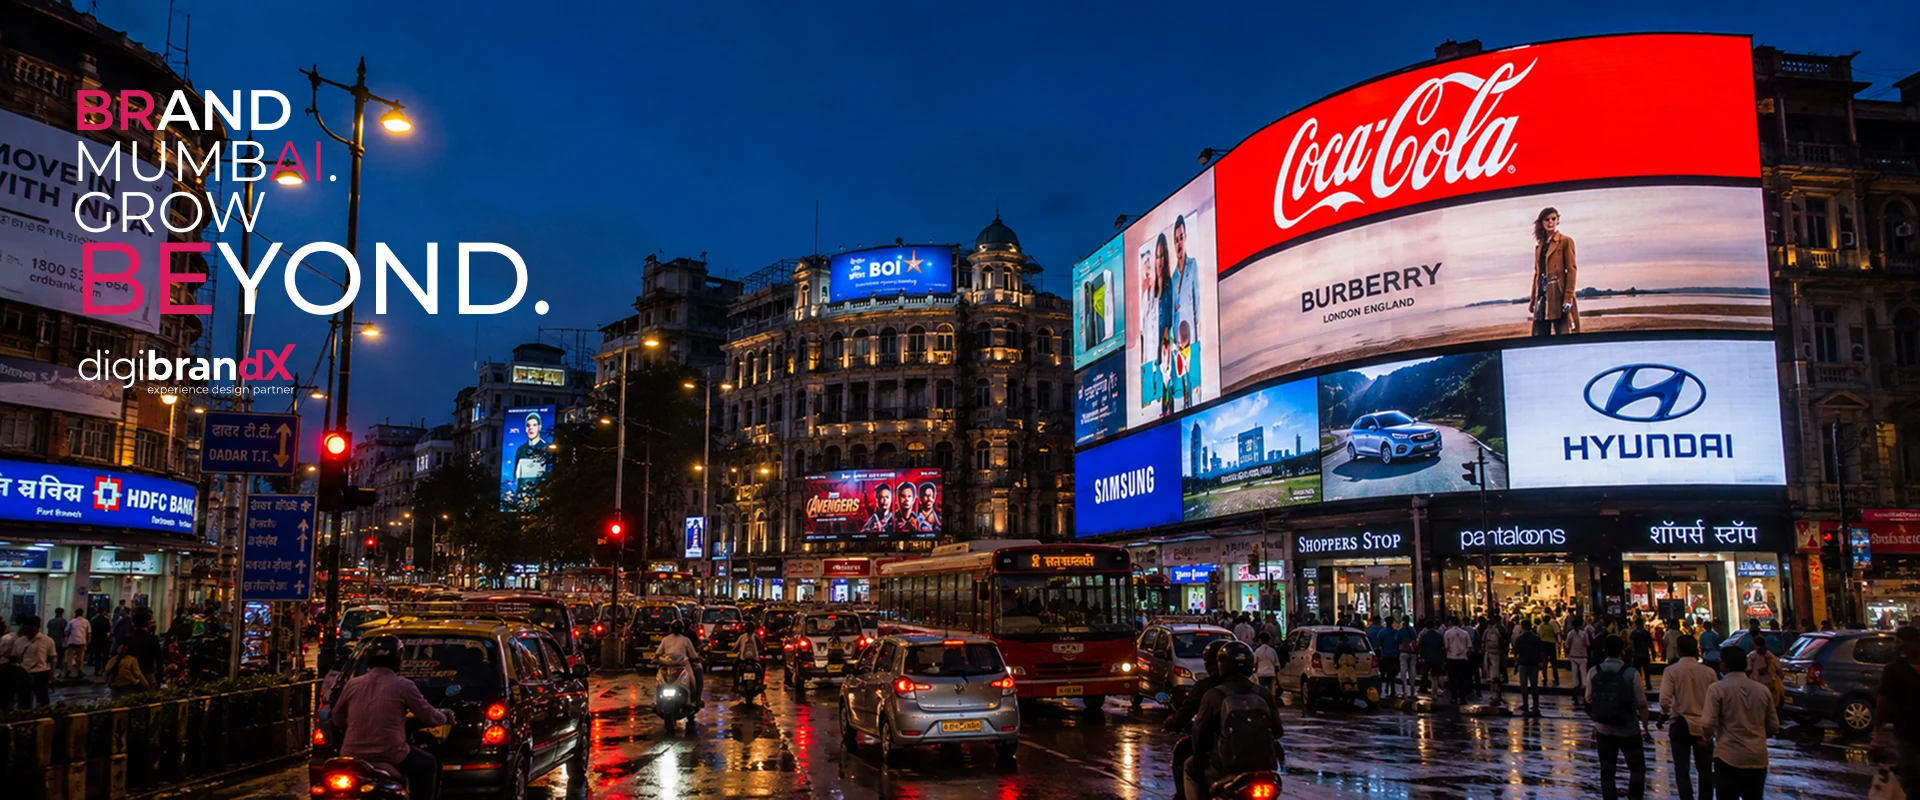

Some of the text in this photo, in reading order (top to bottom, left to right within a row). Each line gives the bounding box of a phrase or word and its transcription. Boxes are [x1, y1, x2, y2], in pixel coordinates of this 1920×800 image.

[1273, 57, 1538, 229] Coca-Cola
[0, 171, 60, 207] ITH
[71, 192, 152, 237] INDA.
[31, 257, 66, 276] 1800
[29, 274, 102, 298] crdbank.cm
[1301, 262, 1443, 314] BURBERRY
[1323, 297, 1415, 324] LONDON ENGLAND
[209, 448, 248, 462] DADAR
[1564, 433, 1733, 461] HYUNDAI
[1095, 465, 1155, 504] SAMSUNG
[126, 488, 168, 512] HDFC
[806, 494, 860, 519] AVENGERS
[1298, 535, 1358, 553] SHOPPERS
[1362, 531, 1401, 550] STOP
[1461, 525, 1567, 551] pantaloons
[1650, 520, 1758, 545] शॉपर्स स्टॉप
